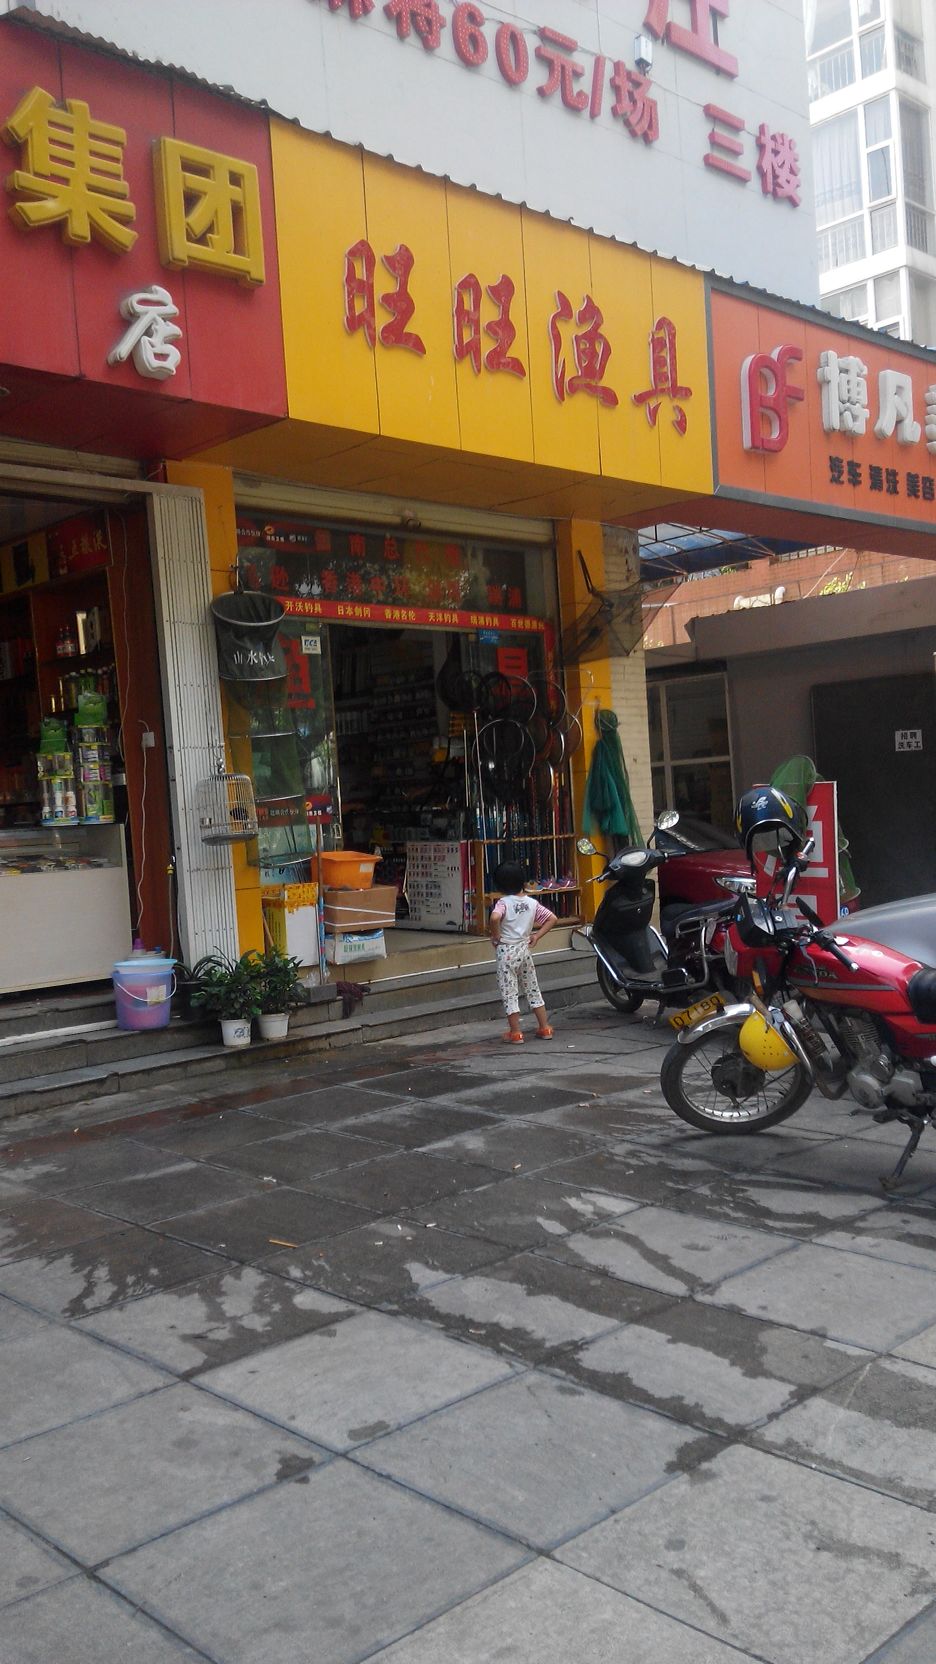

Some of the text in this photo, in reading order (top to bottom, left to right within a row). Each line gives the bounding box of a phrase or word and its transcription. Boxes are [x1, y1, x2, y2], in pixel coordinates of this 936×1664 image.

[2, 86, 266, 289] 集团
[703, 103, 801, 208] 三楼
[107, 285, 184, 380] 店
[343, 239, 693, 436] 旺旺渔具
[817, 350, 936, 455] 博凡
